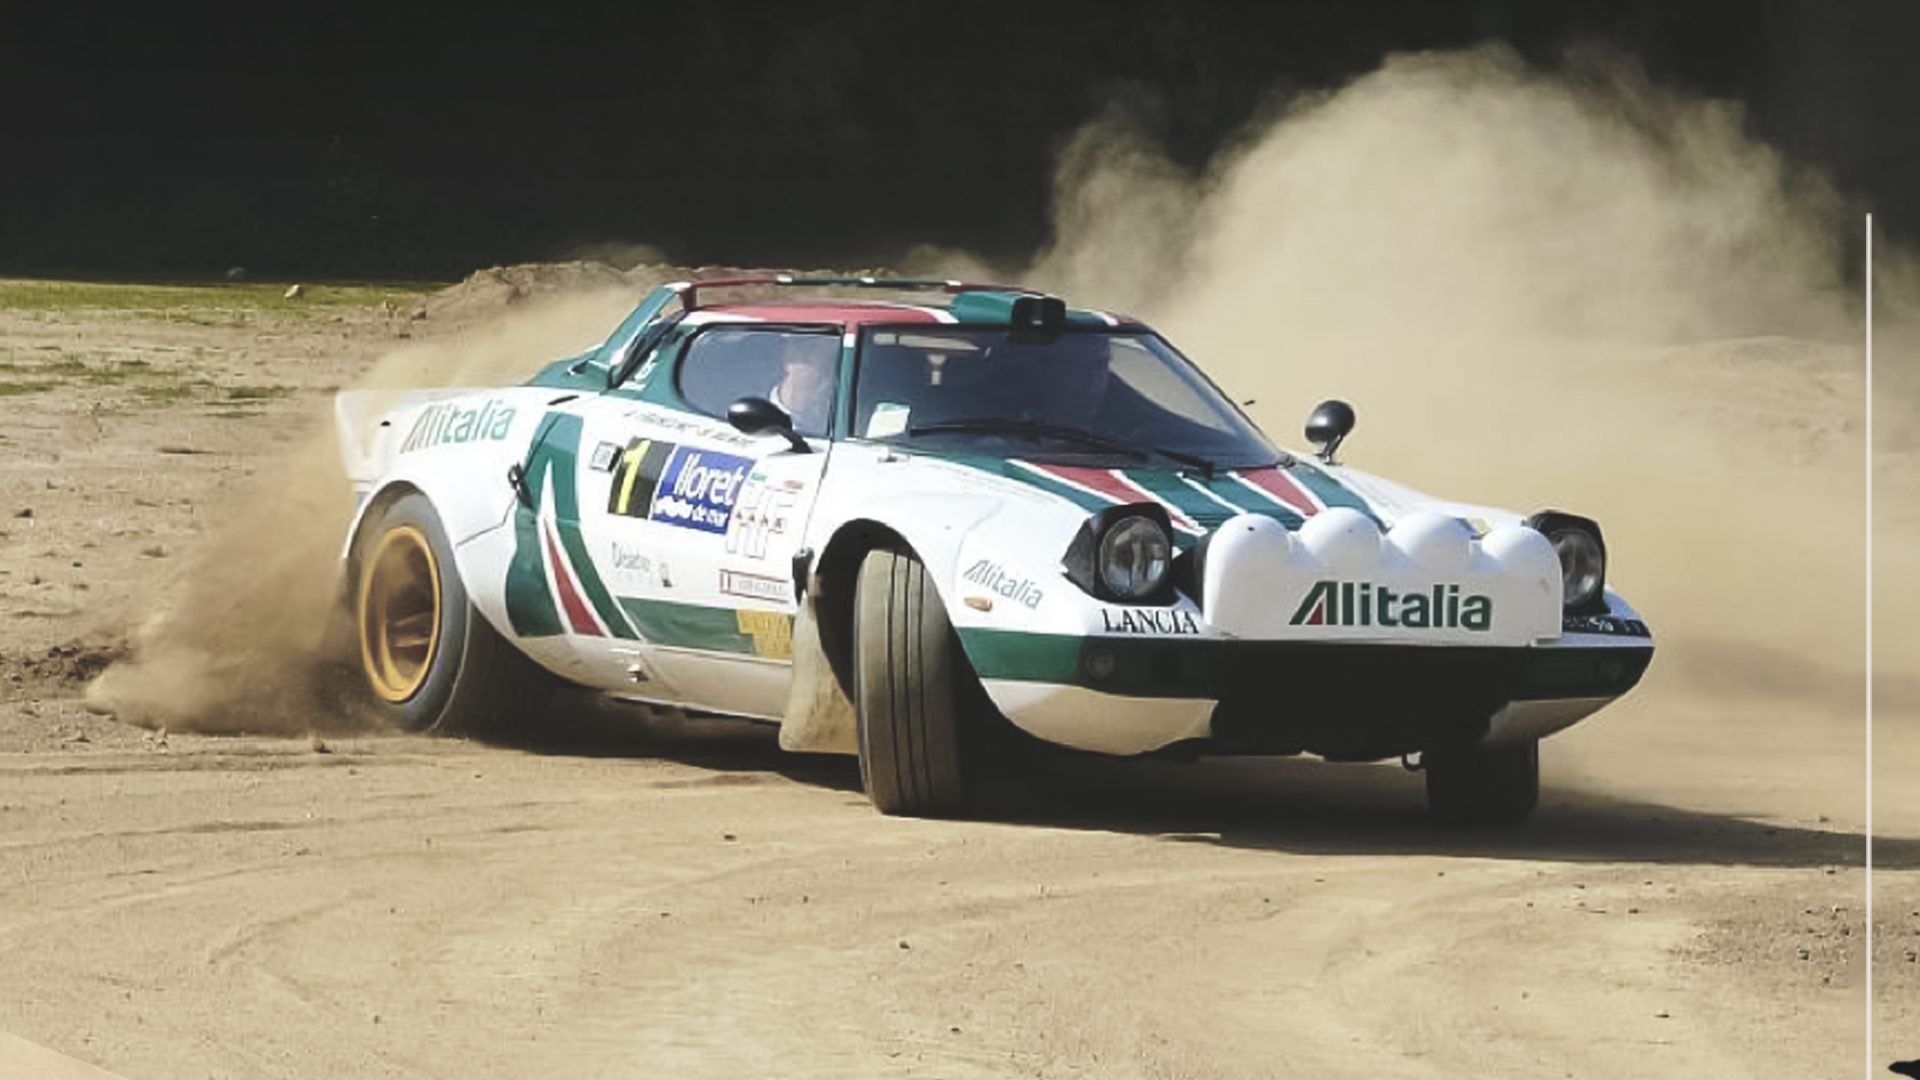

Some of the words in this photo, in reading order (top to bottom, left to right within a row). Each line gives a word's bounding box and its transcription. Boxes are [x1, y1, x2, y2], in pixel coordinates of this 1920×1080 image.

[399, 399, 517, 454] Alitalia
[616, 439, 651, 514] 1
[963, 559, 1043, 609] Alitalia
[1288, 581, 1493, 632] Alitalia
[1101, 608, 1200, 635] LANCIA
